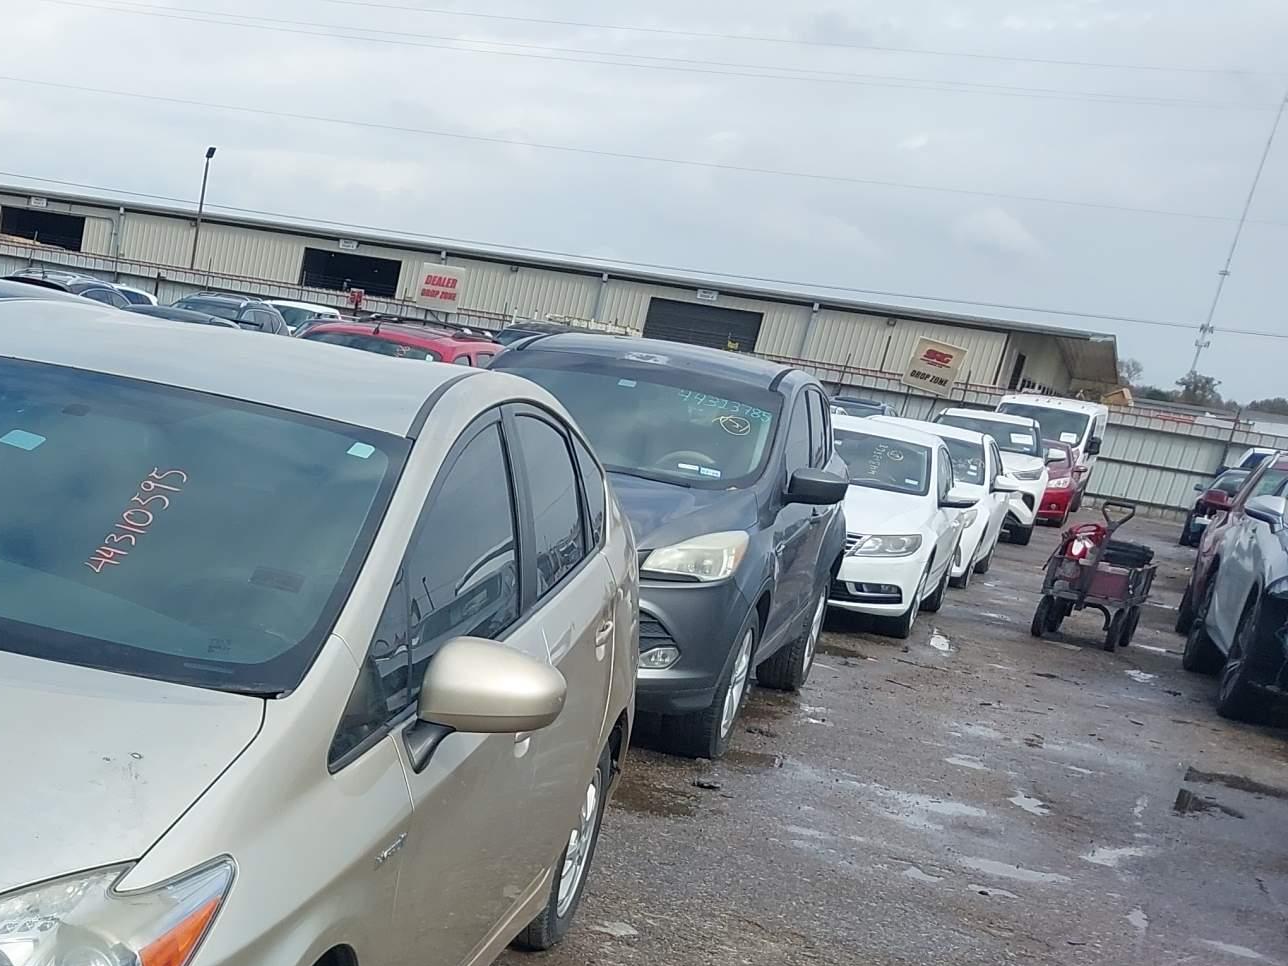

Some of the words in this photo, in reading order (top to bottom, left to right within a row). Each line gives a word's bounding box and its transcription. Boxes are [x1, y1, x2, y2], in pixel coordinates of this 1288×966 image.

[424, 274, 458, 288] DEALER
[421, 288, 440, 298] DROP
[440, 291, 457, 301] ZONE
[910, 369, 931, 381] DROP
[929, 375, 949, 387] ZONE
[678, 388, 772, 423] 44313785
[83, 466, 187, 573] 44310595
